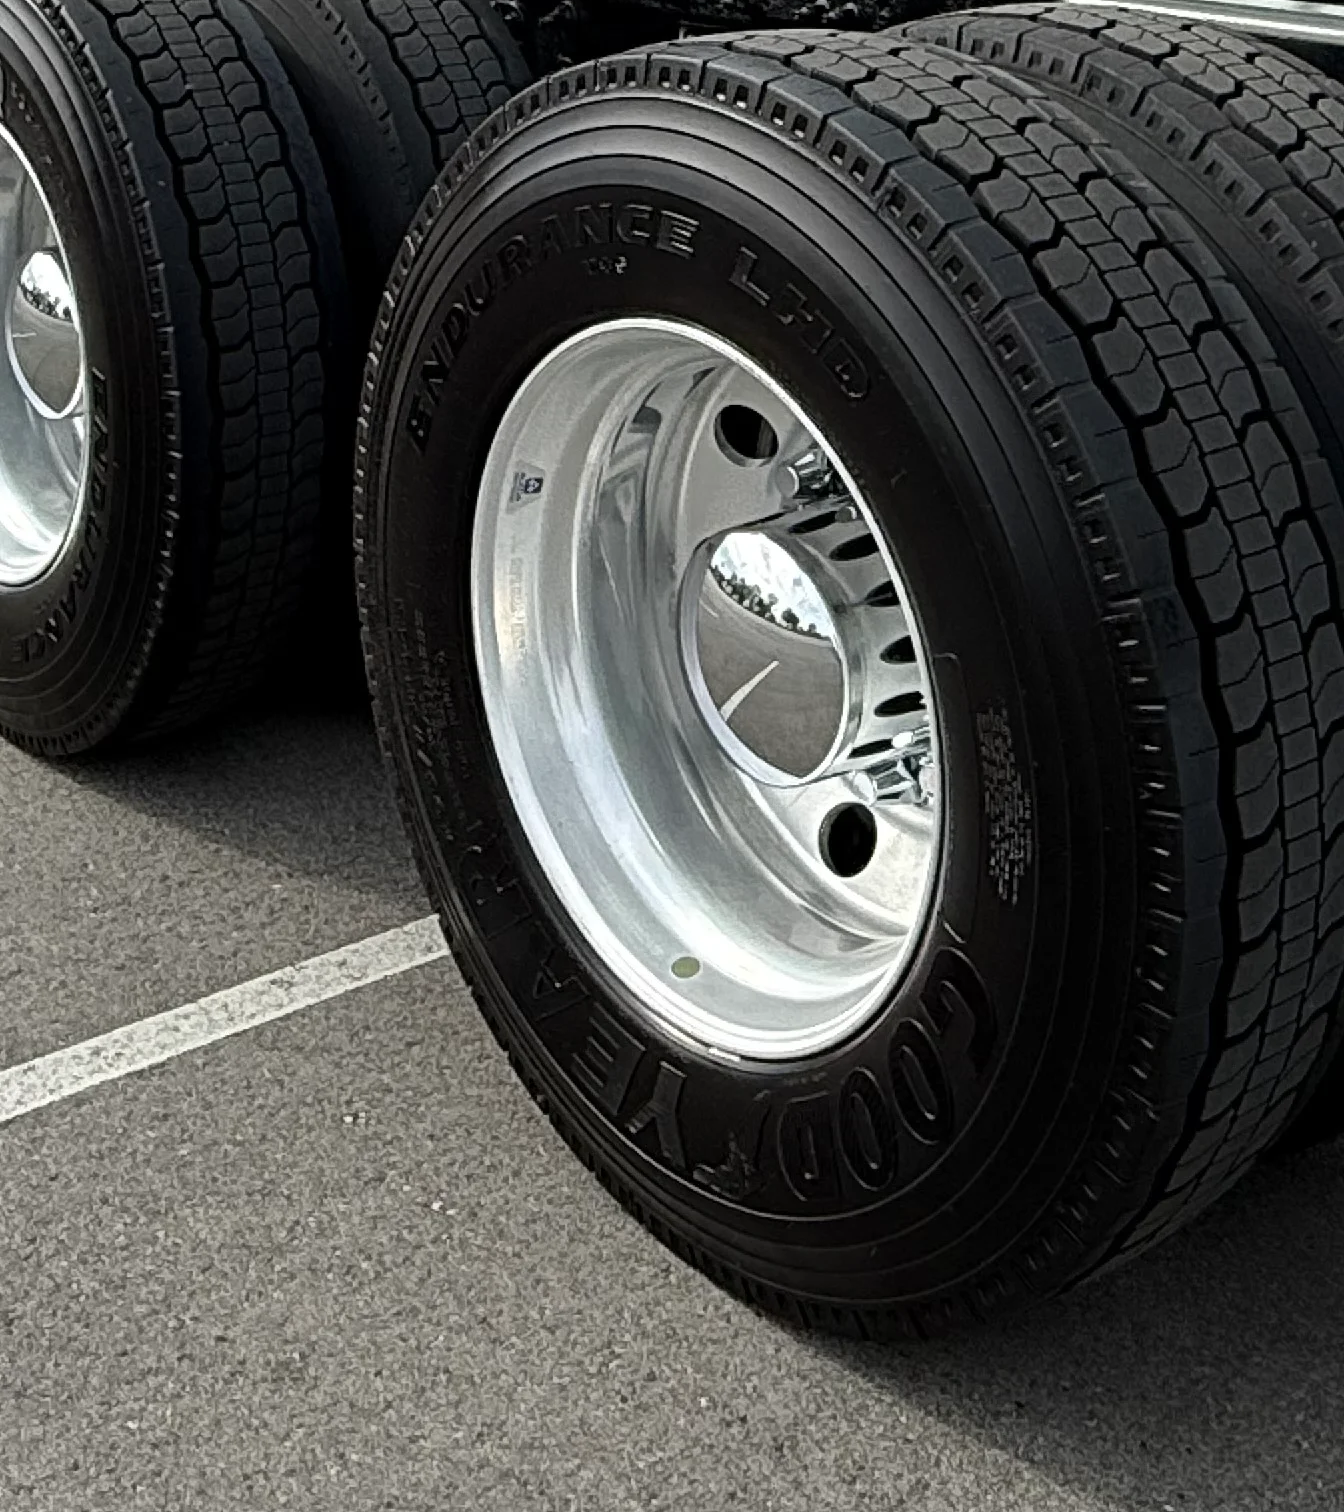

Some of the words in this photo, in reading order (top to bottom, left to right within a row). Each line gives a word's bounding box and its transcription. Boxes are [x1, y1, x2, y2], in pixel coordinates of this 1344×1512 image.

[407, 202, 702, 455] ENDURANCE
[728, 245, 872, 403] LHD
[474, 878, 998, 1206] GOODYEAR
